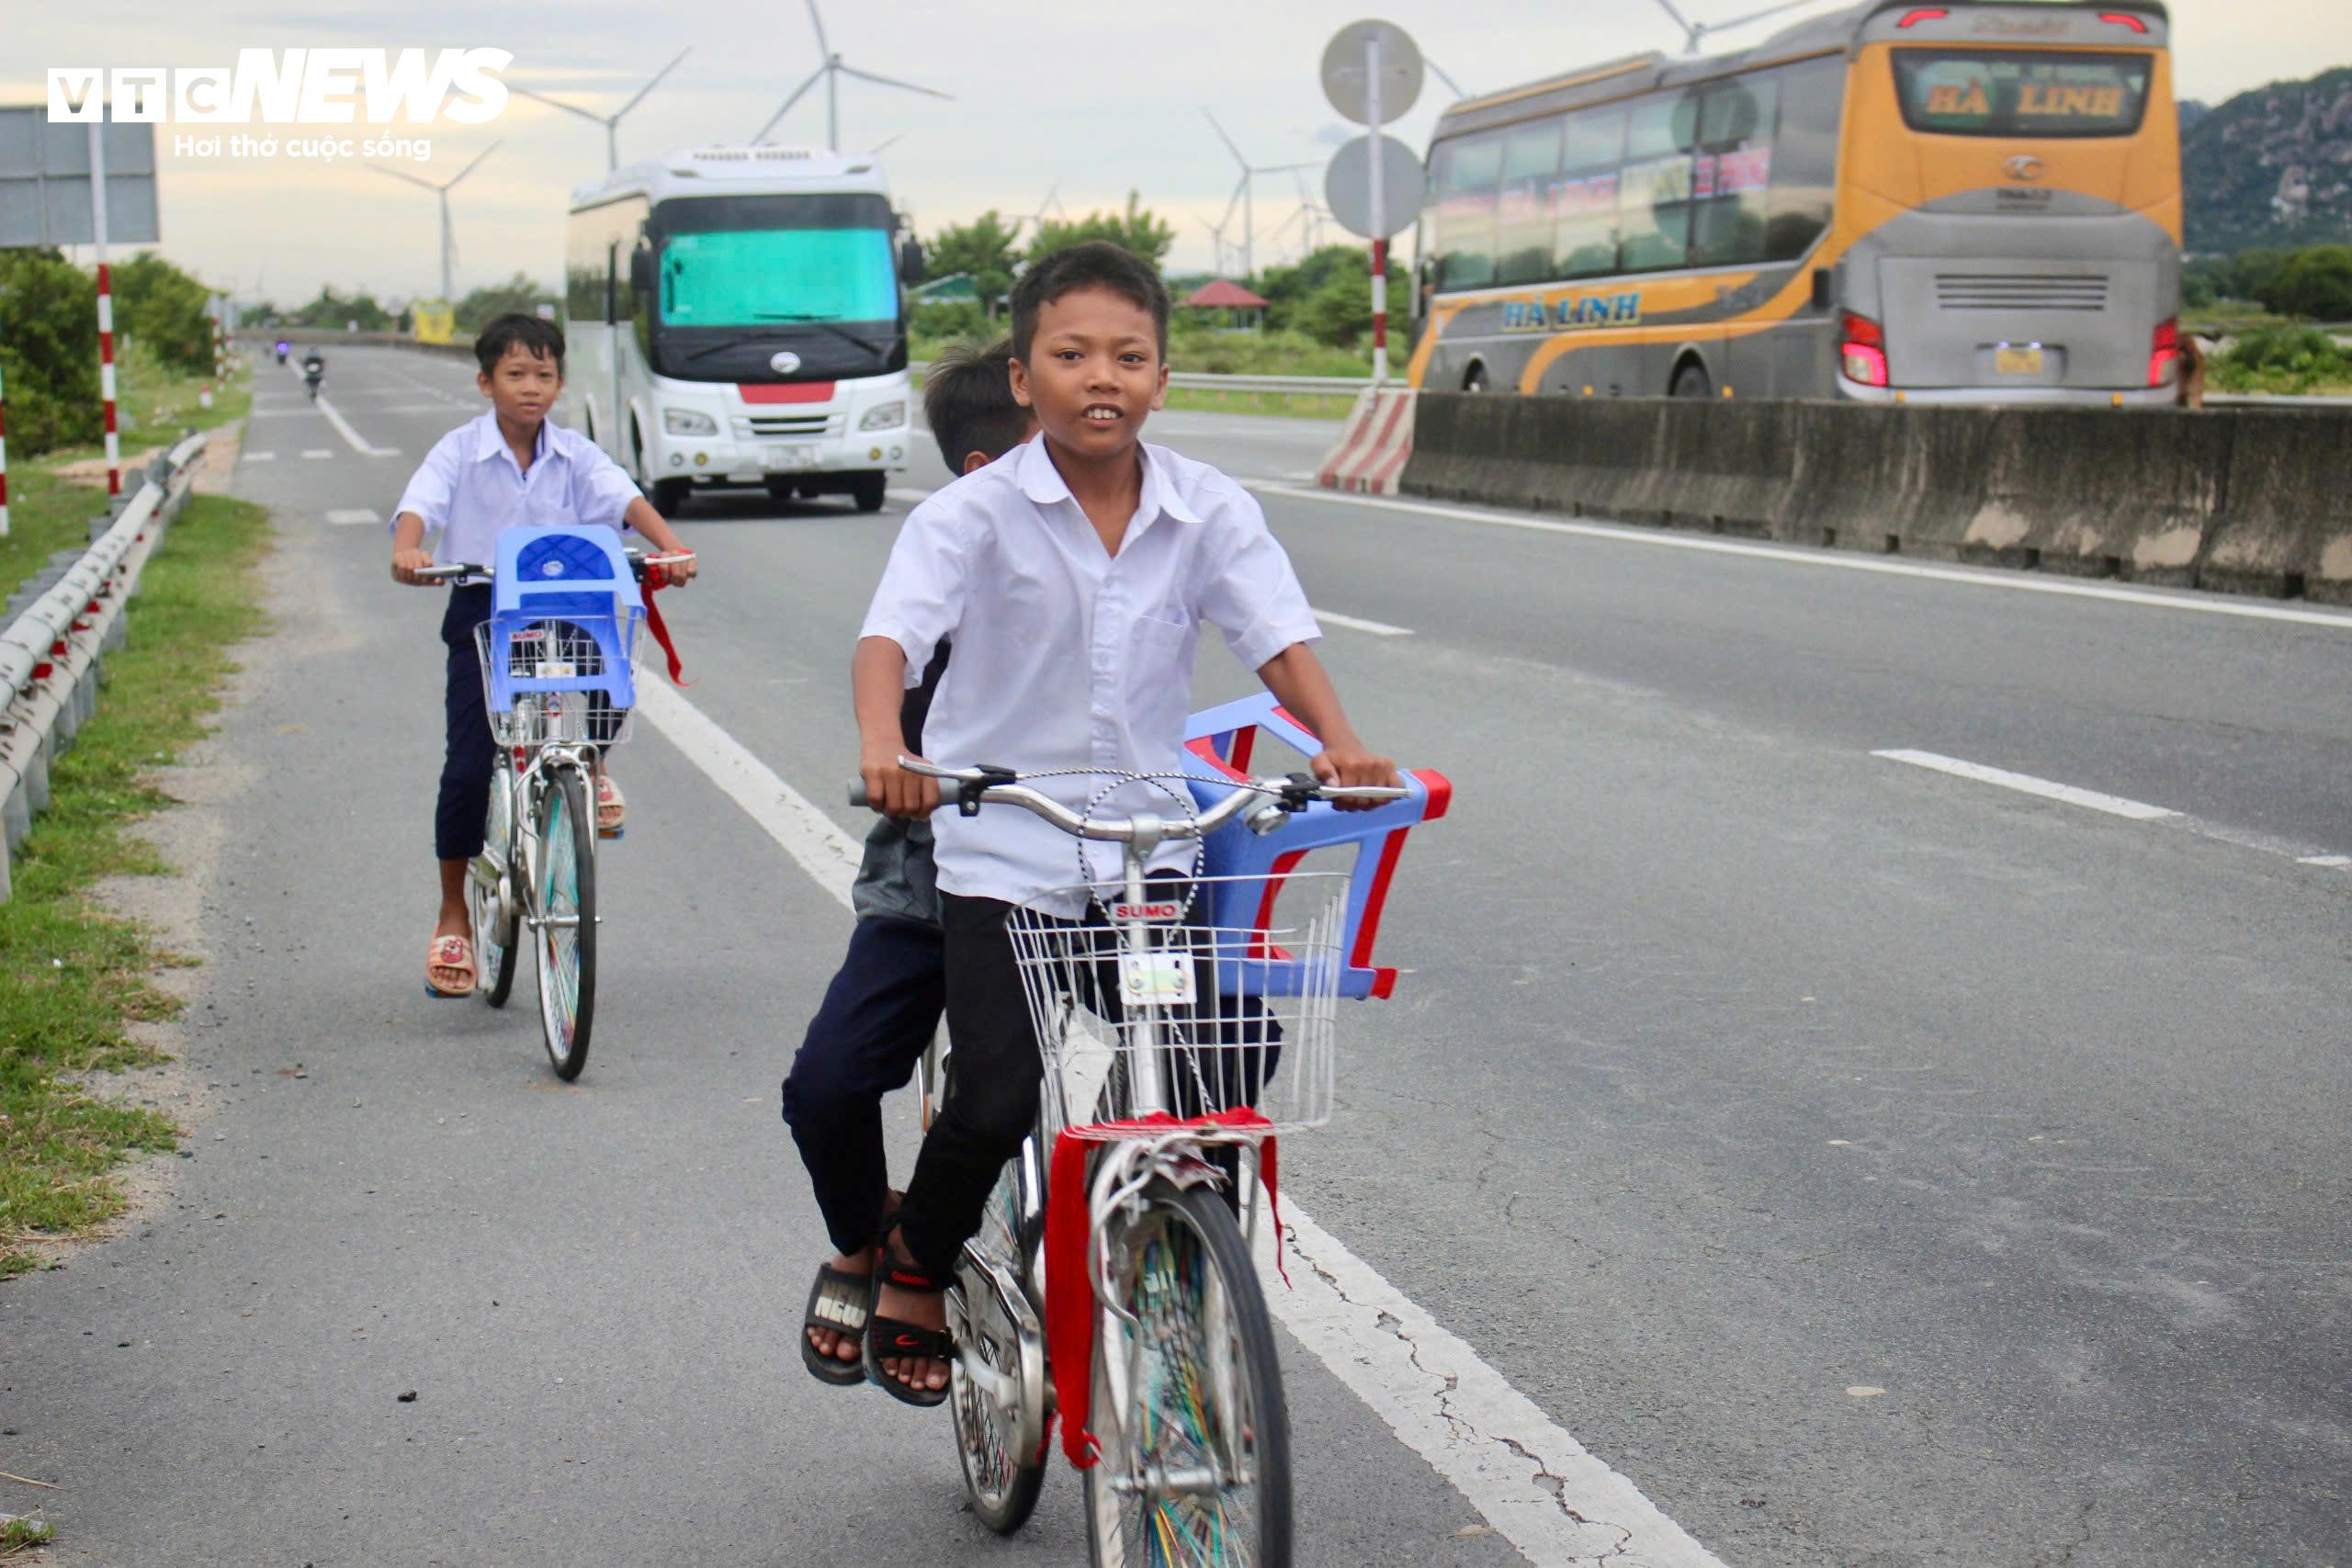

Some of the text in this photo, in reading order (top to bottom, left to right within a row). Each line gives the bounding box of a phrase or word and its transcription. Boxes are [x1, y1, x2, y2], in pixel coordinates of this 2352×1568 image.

[2018, 85, 2124, 116] LINH
[1556, 292, 1640, 329] LINH
[1115, 903, 1176, 918] SUMO
